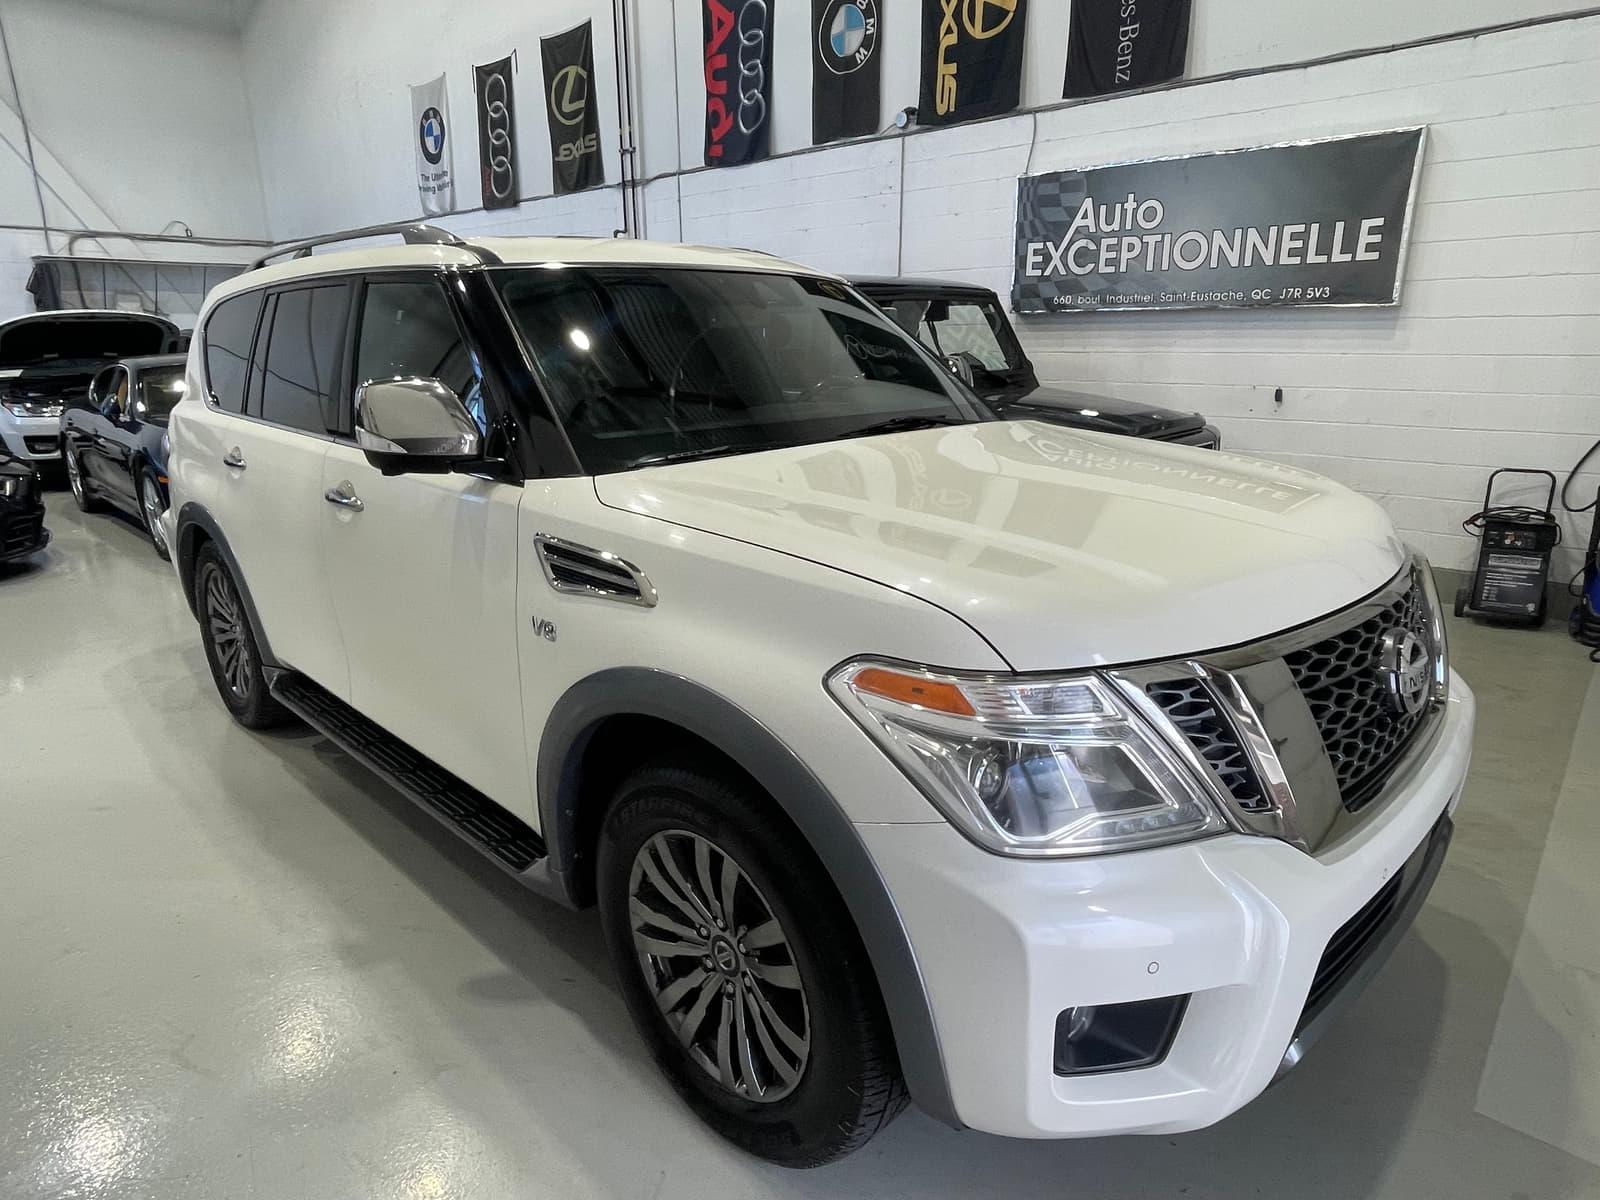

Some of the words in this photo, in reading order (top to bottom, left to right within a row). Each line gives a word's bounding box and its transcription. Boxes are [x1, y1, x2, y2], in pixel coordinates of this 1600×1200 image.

[1070, 193, 1164, 234] Auto
[1025, 216, 1385, 277] EXCEPTIONNELLE
[1160, 290, 1247, 303] Saint-Eustache,
[1251, 289, 1272, 300] QC
[1280, 287, 1302, 299] J7R
[1306, 286, 1331, 299] 5V3
[531, 615, 557, 643] V8
